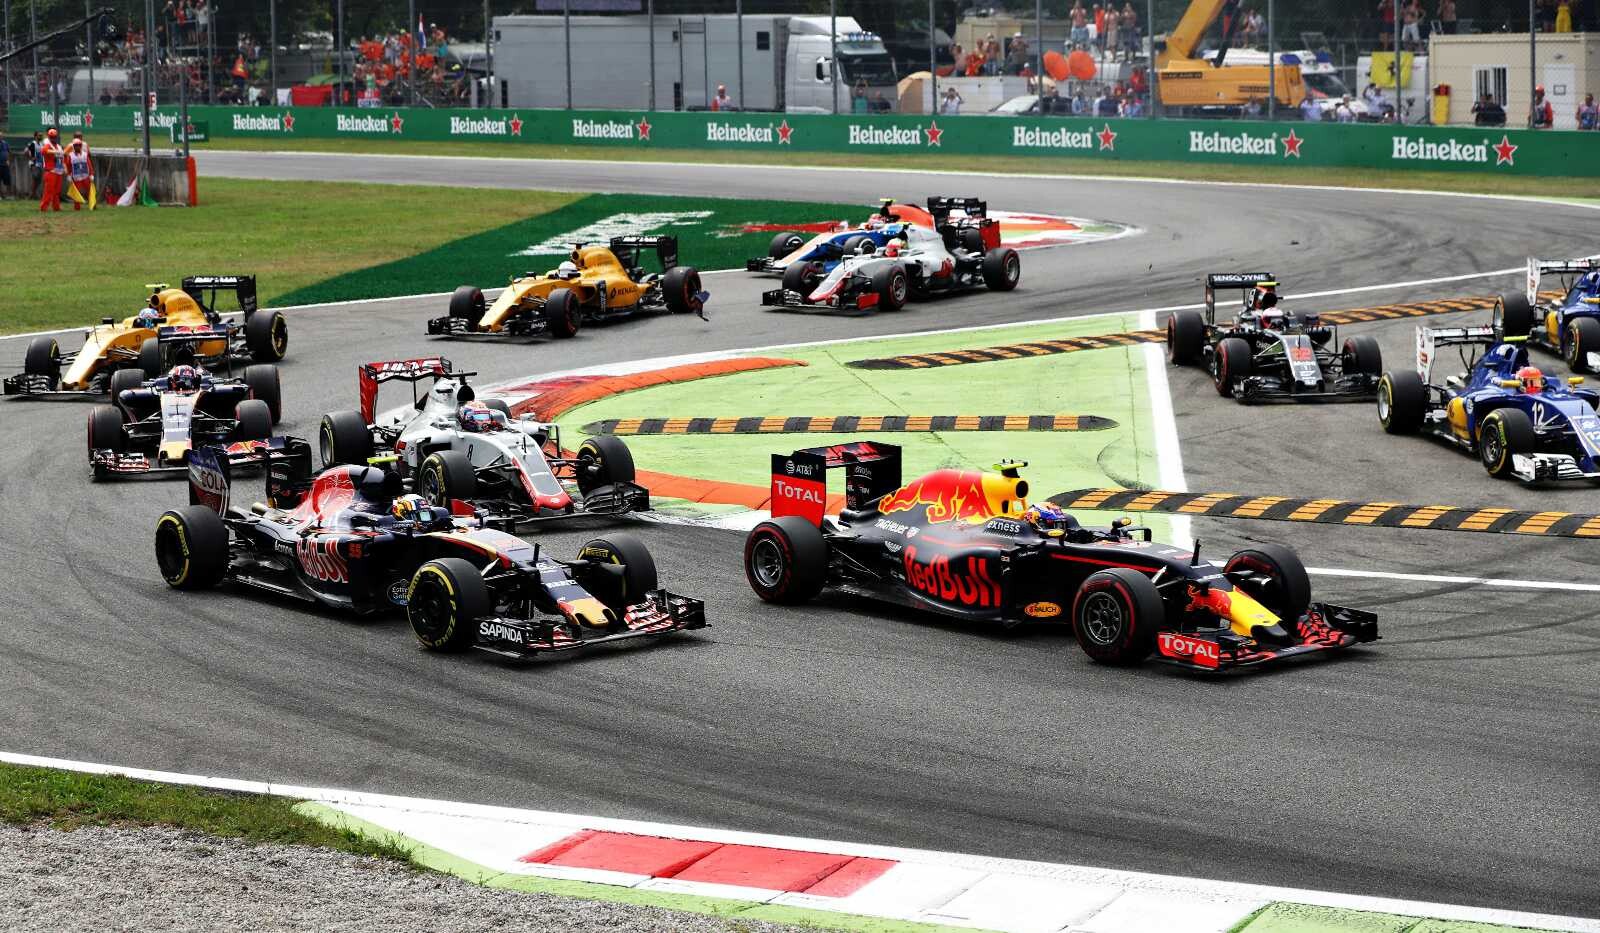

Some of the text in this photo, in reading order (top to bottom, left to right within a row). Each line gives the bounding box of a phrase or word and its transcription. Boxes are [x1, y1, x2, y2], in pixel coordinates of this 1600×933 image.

[133, 111, 177, 128] Heneken
[233, 114, 280, 131] Heineken
[337, 114, 388, 132] Heineken
[450, 117, 506, 134] Heineken
[573, 119, 633, 139] Heineken
[707, 123, 772, 142] Heineken
[849, 125, 921, 145] Heineken
[1013, 126, 1092, 148] Heineken
[1189, 131, 1276, 154] Heineken
[1392, 136, 1487, 162] Heineken
[796, 464, 813, 476] AT&T
[775, 480, 823, 504] TOTAL
[988, 520, 1020, 533] exness
[480, 621, 523, 645] SAPINDA
[1163, 635, 1218, 660] TOTAL
